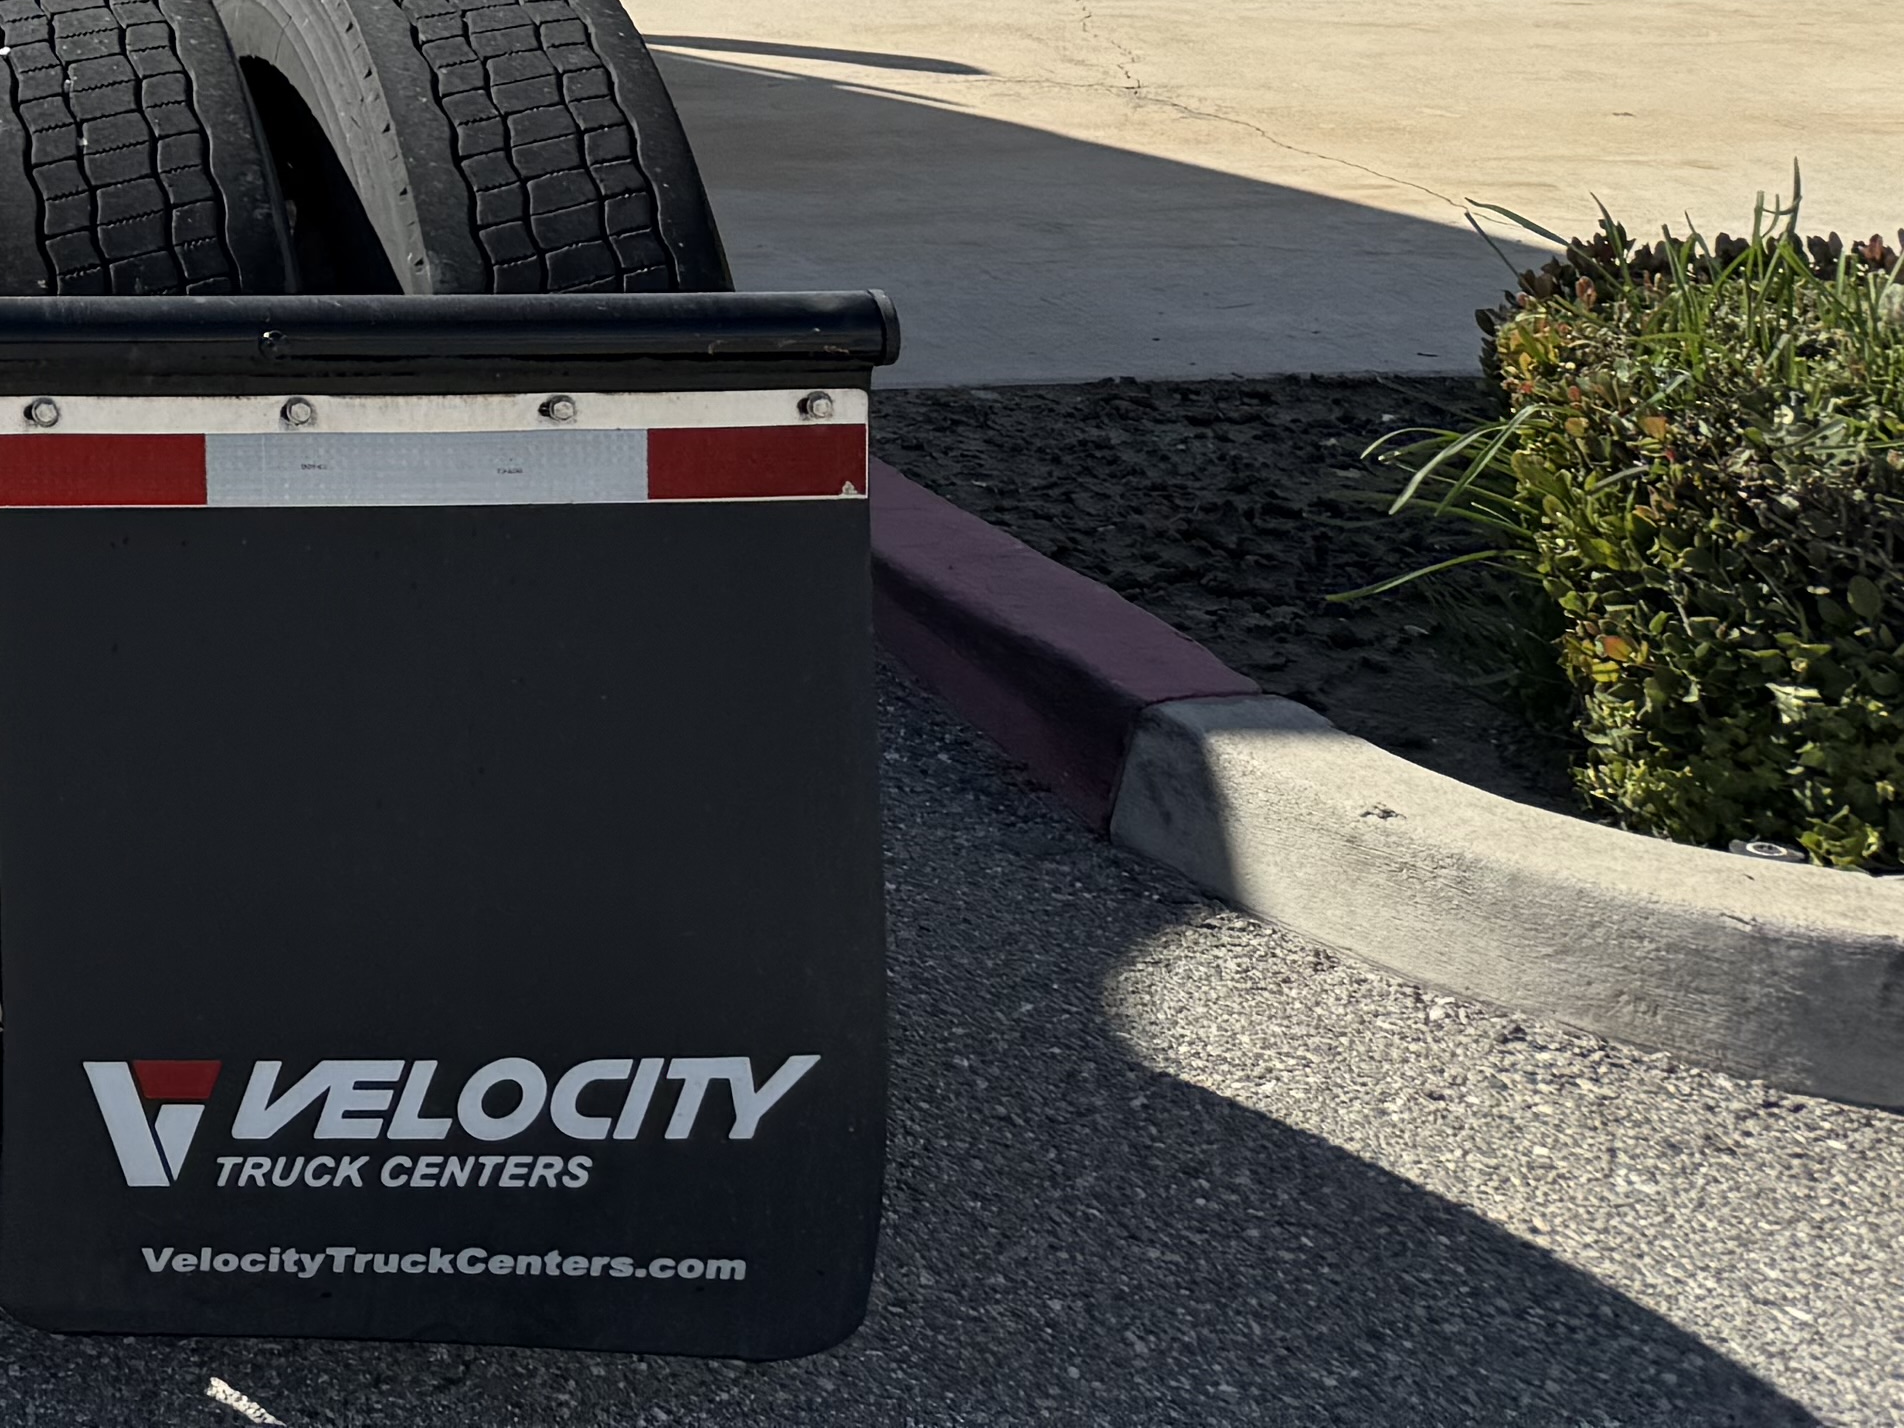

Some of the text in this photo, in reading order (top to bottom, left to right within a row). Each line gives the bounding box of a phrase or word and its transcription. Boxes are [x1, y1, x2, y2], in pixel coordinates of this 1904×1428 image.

[231, 1054, 822, 1141] VELOCITY
[215, 1155, 593, 1189] TRUCK CENTERS
[141, 1247, 747, 1280] VelocityTruckCenters.com
